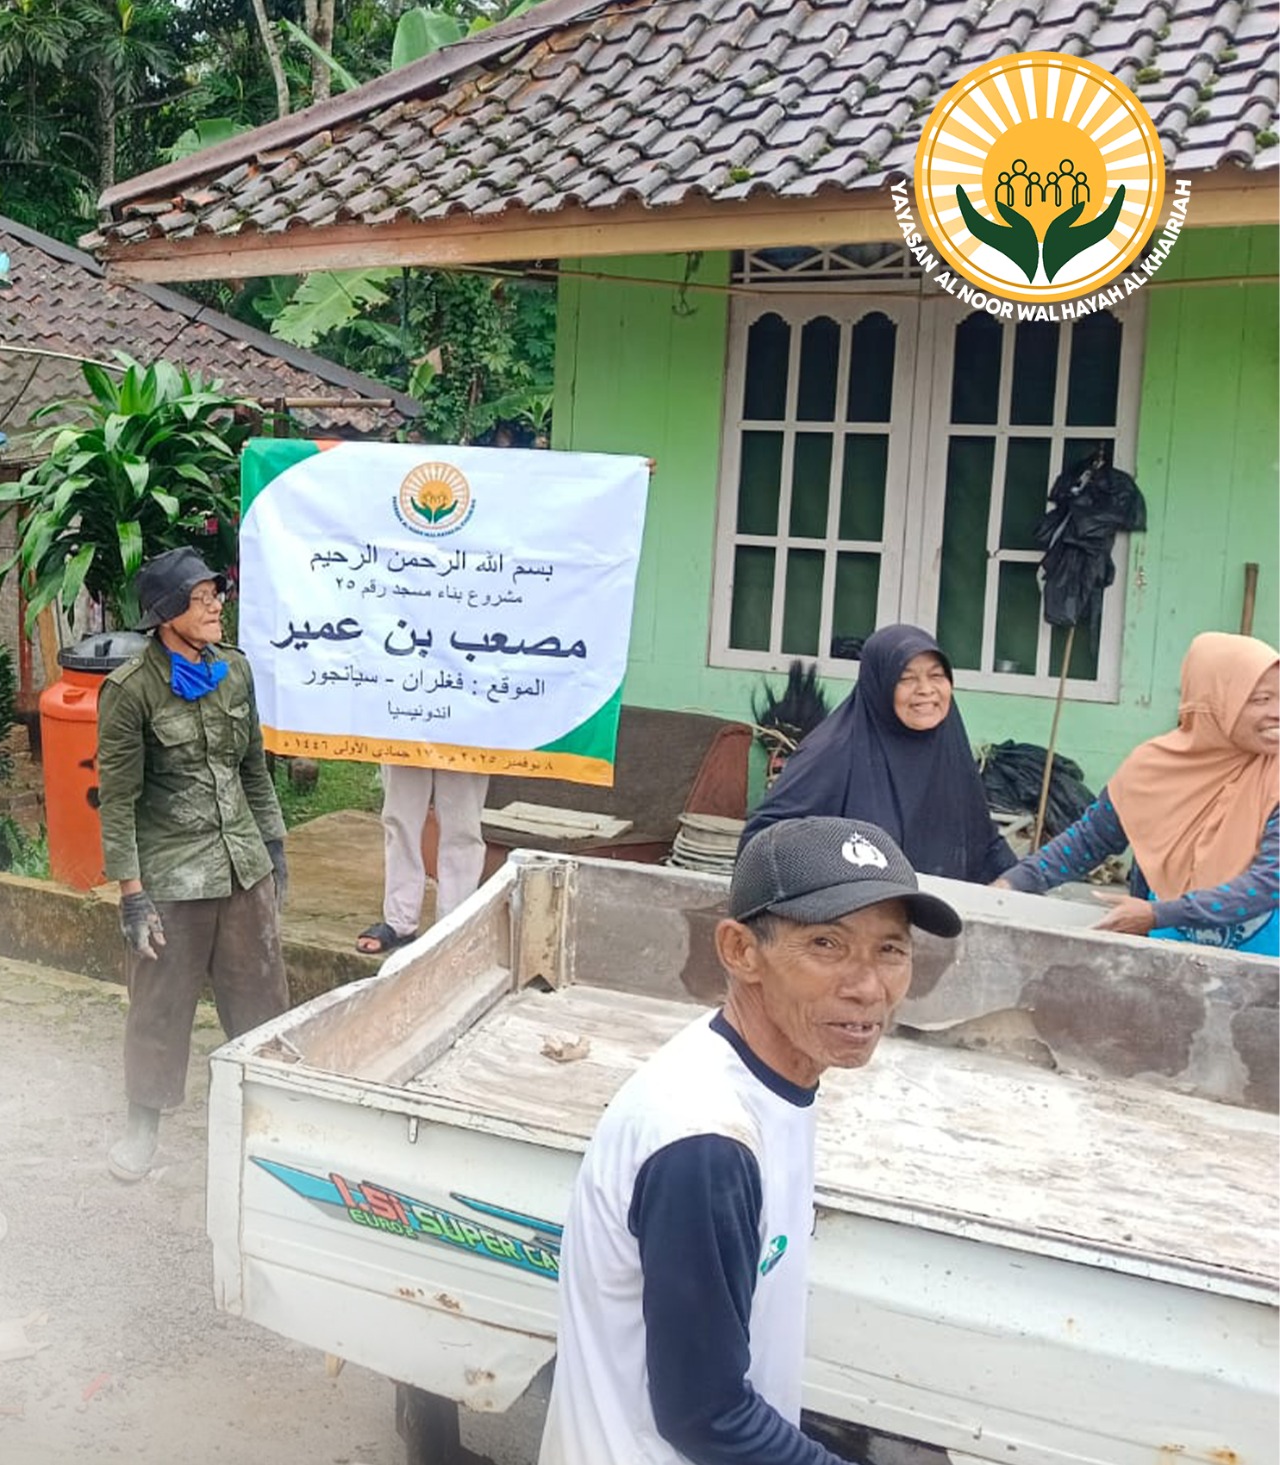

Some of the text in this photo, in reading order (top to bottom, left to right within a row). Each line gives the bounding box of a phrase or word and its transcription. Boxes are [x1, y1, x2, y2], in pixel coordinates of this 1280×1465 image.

[310, 543, 554, 585] بسم الله الرحمن الرحيم
[335, 576, 523, 608] مشروع بناء مسجد رقم ٢٥
[270, 617, 587, 663] مصعب بن عمير
[301, 665, 378, 687] سيانجور
[486, 675, 545, 703] الموقع
[388, 701, 451, 722] اندونيسيا
[411, 1204, 524, 1262] SUPER
